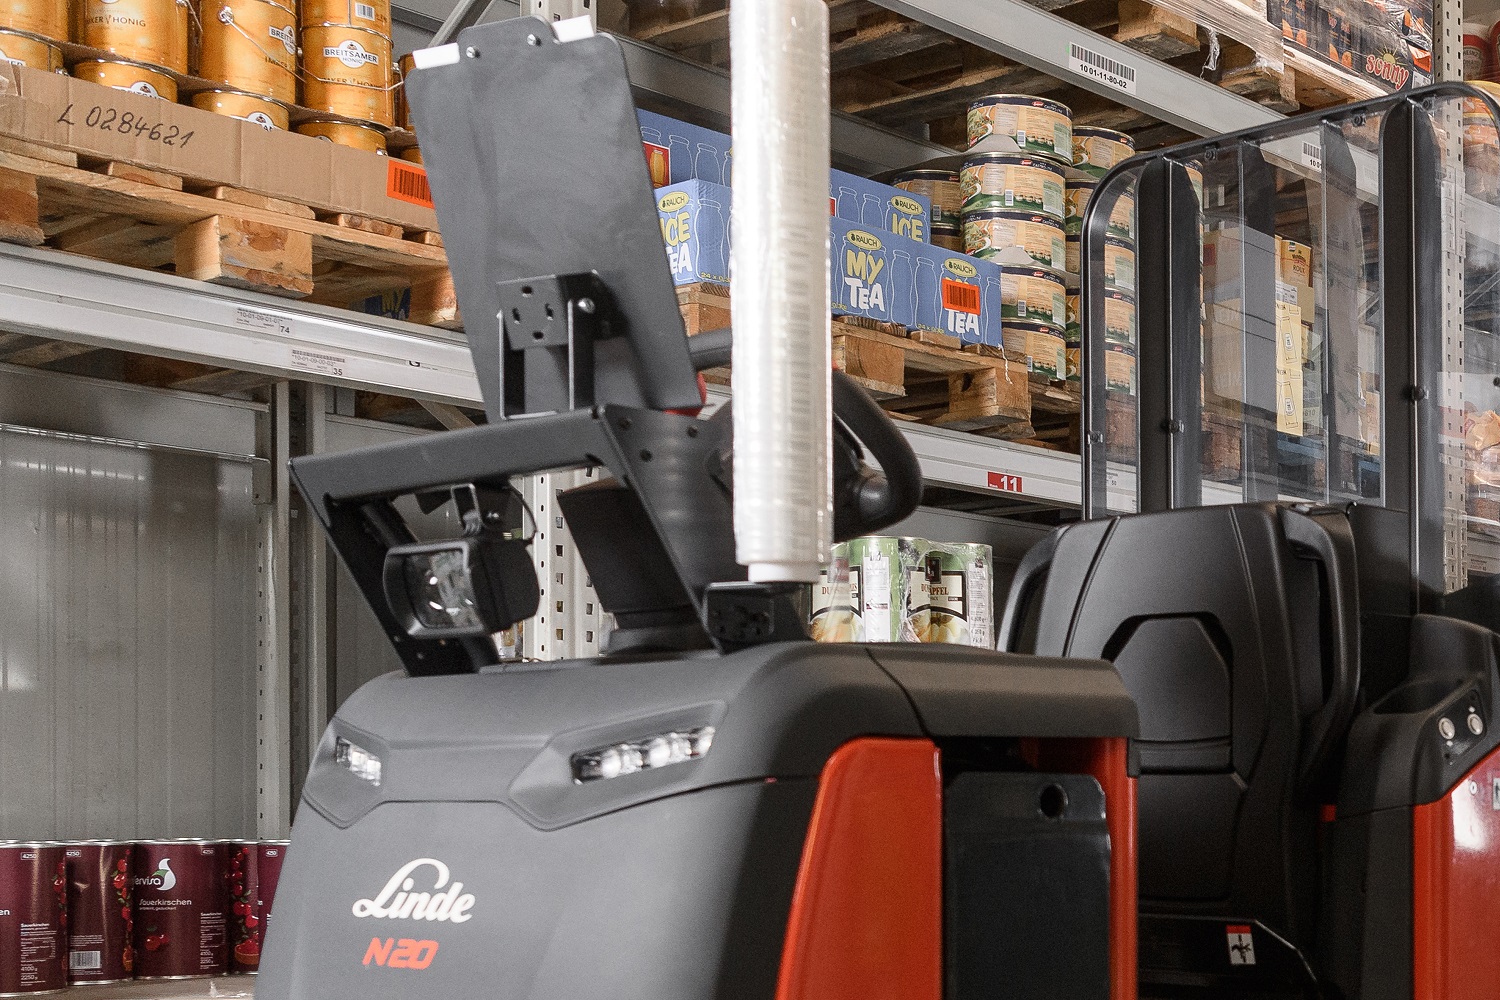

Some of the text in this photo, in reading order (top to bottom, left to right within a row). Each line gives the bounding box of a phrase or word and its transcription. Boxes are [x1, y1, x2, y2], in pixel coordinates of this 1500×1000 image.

[112, 15, 146, 27] HONIG
[324, 48, 378, 63] BREITSAMER
[342, 57, 363, 65] HONIG
[1079, 63, 1088, 73] 10
[1366, 53, 1409, 91] sonny
[57, 104, 195, 149] L 0284621
[663, 195, 686, 208] RAUCH
[898, 198, 923, 214] RAUCH
[891, 213, 923, 242] ICE
[856, 233, 880, 248] RAUCH
[847, 250, 884, 285] MY
[953, 261, 975, 275] RAUCH
[844, 277, 886, 313] TEA
[279, 325, 290, 334] 74
[946, 308, 980, 336] TEA
[333, 367, 343, 376] 35
[1001, 475, 1018, 492] 11
[352, 858, 476, 914] Linde
[362, 937, 440, 971] N20
